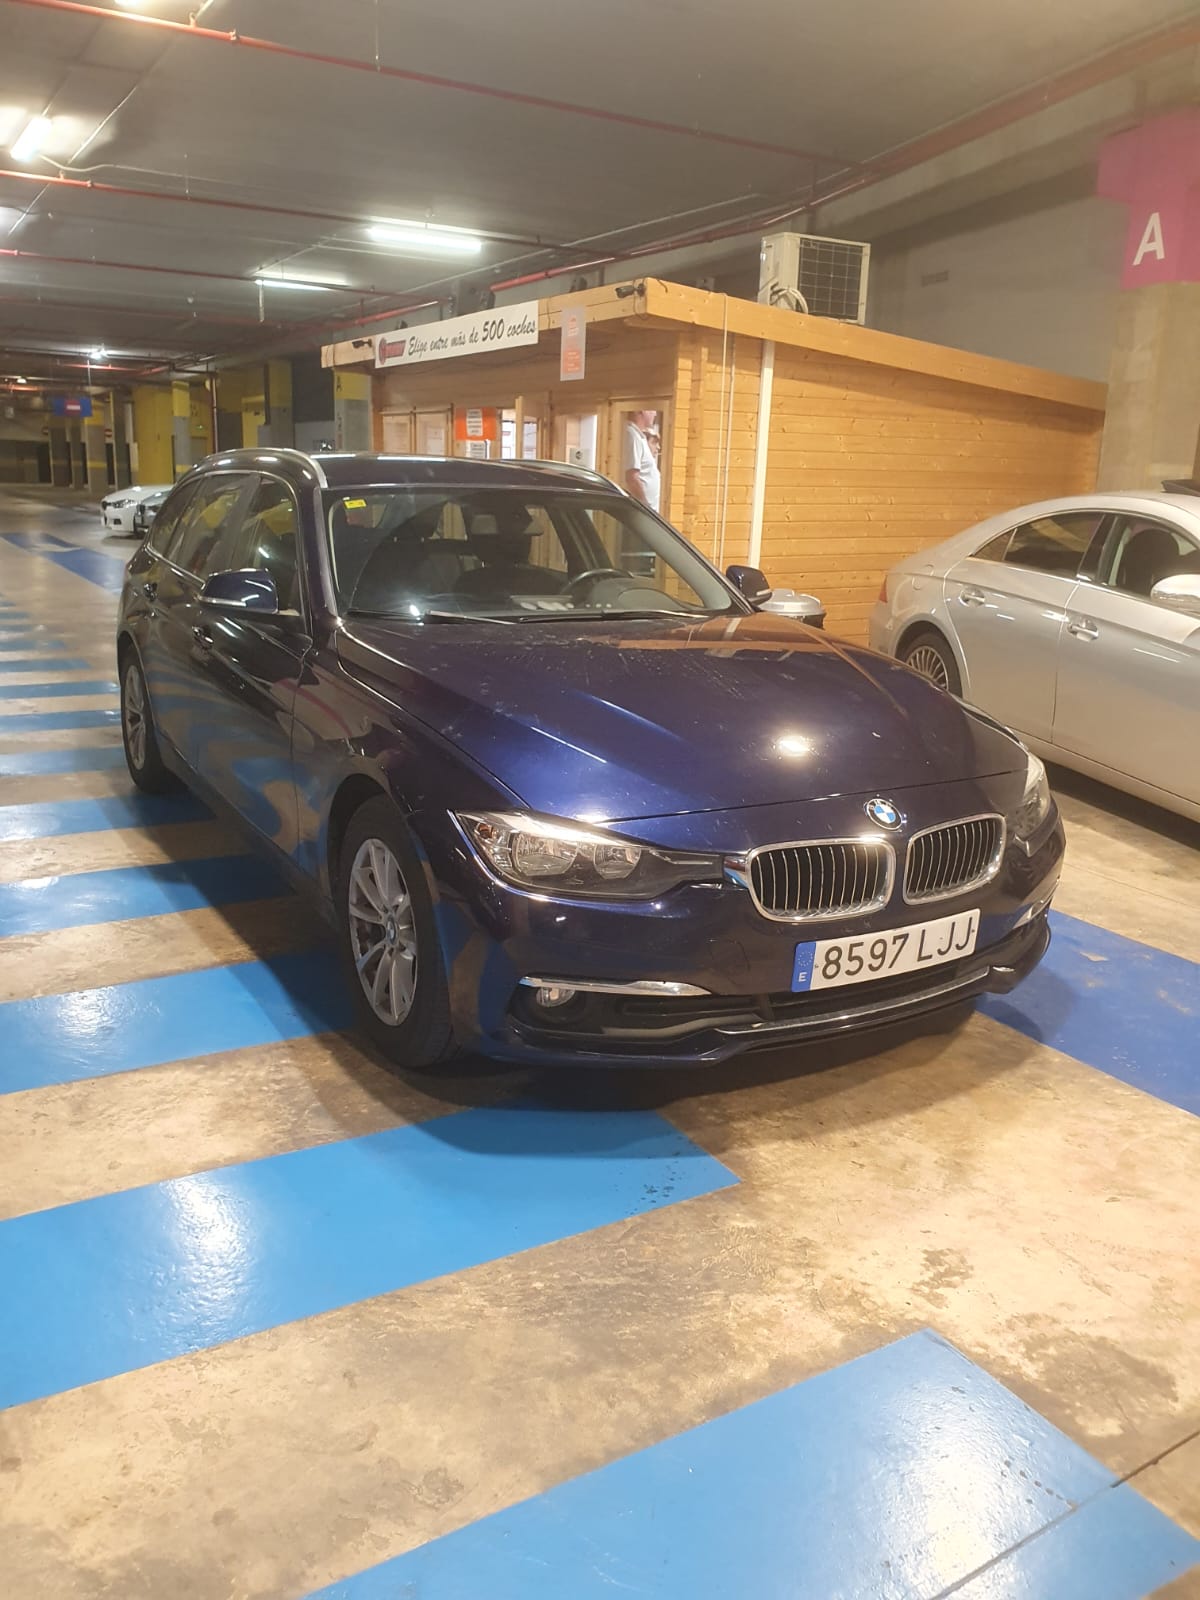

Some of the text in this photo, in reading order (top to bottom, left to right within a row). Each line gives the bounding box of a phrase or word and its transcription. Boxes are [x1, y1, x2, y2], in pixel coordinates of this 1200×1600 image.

[1132, 212, 1165, 266] A
[408, 336, 428, 358] Elige
[430, 338, 448, 350] entre
[451, 332, 466, 347] más
[469, 327, 479, 344] de
[482, 318, 505, 341] 500
[507, 314, 536, 337] coches
[822, 916, 973, 980] 8597 LJJ
[798, 972, 807, 982] E
